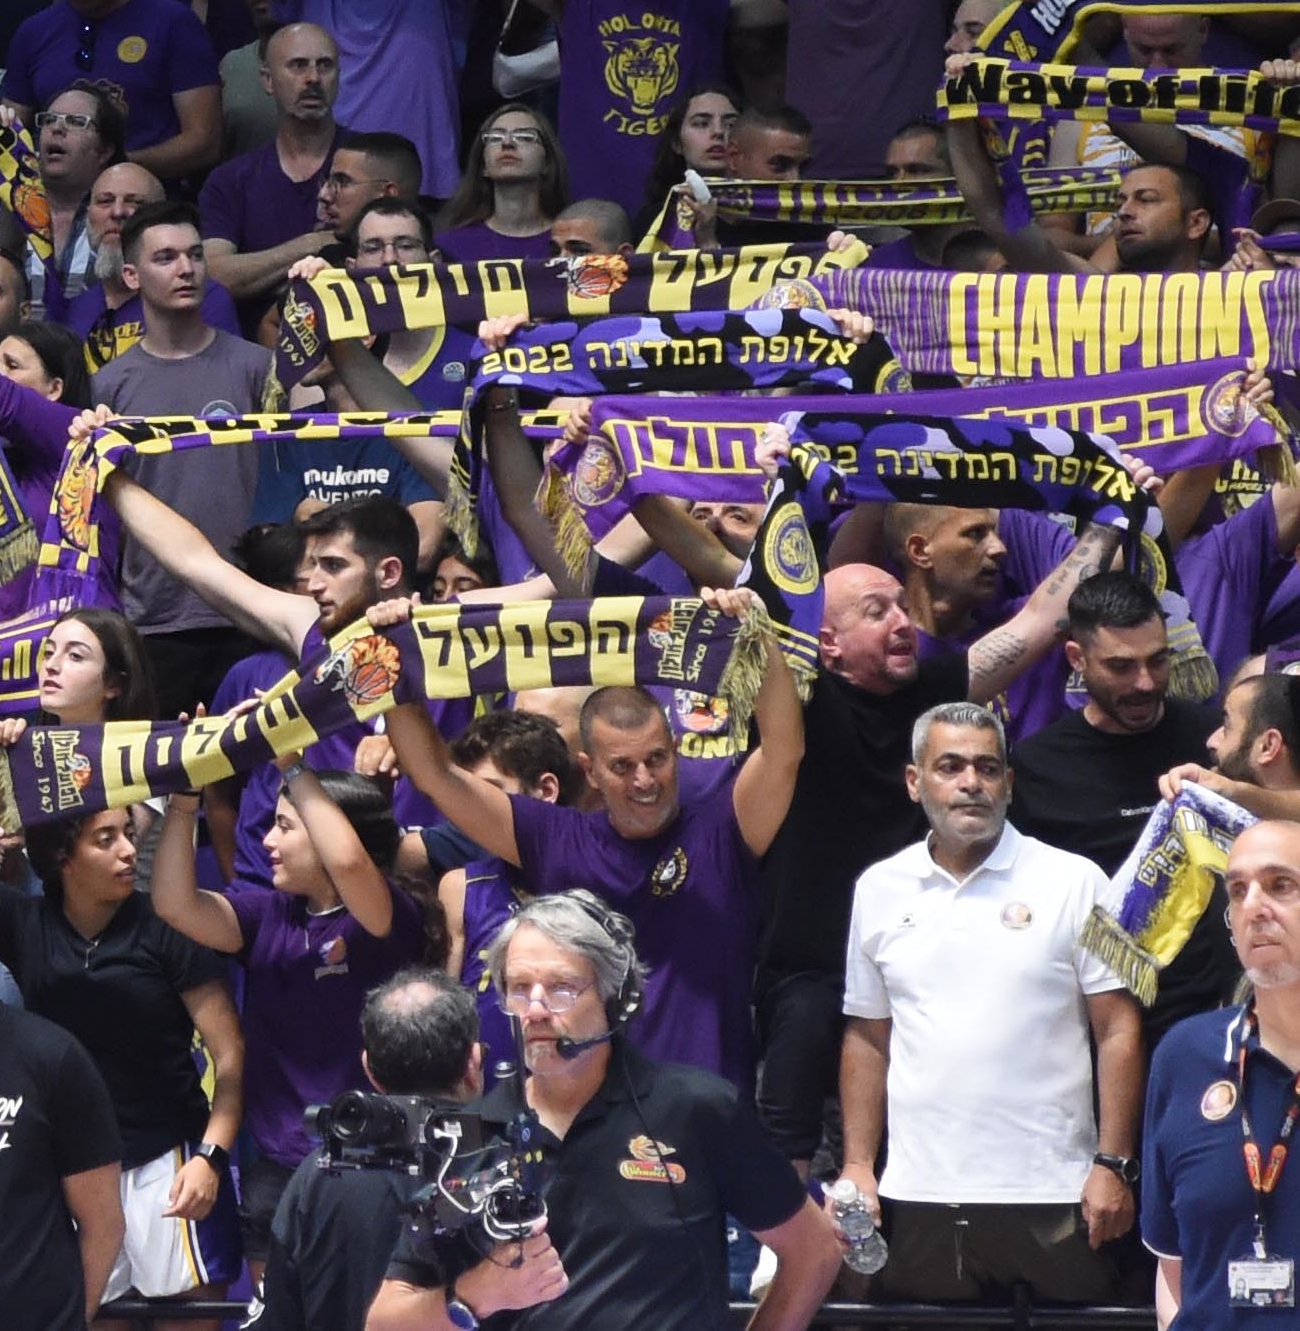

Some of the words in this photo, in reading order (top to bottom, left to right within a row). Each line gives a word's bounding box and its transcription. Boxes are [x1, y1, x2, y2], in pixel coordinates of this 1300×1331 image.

[598, 10, 681, 36] HOLONIA
[946, 63, 1088, 110] Way
[1106, 76, 1181, 109] of
[949, 270, 1276, 379] CHAMPIONS
[482, 341, 574, 373] 2022
[588, 335, 724, 370] המדינה
[740, 333, 858, 368] אלופת
[621, 418, 773, 476] חולון
[876, 448, 1017, 482] המדינה
[1033, 452, 1137, 503] אלופת
[37, 776, 54, 814] 1947
